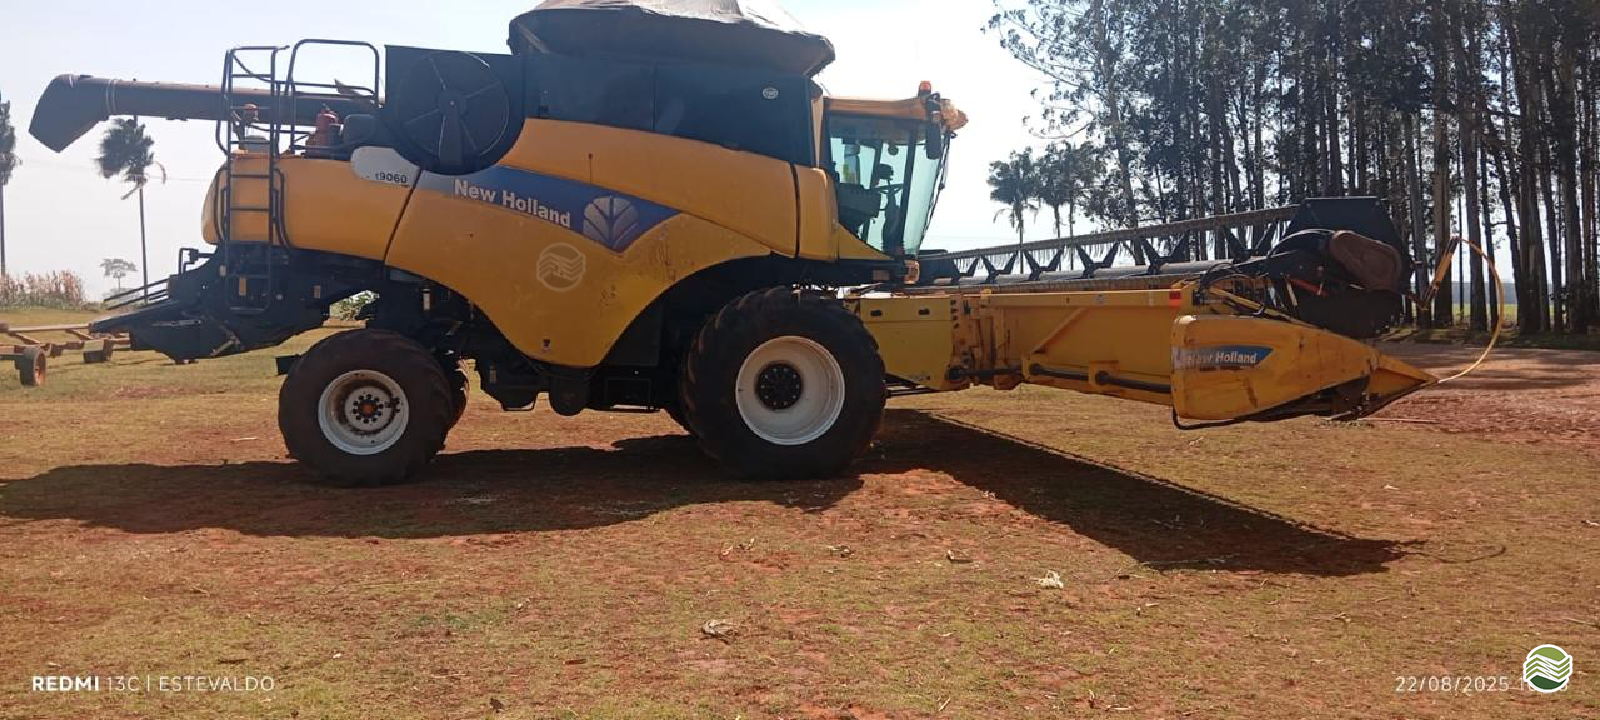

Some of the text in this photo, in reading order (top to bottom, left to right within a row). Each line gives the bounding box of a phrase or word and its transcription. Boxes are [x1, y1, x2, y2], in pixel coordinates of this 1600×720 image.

[454, 179, 571, 228] New Holland
[1215, 351, 1257, 364] Holland
